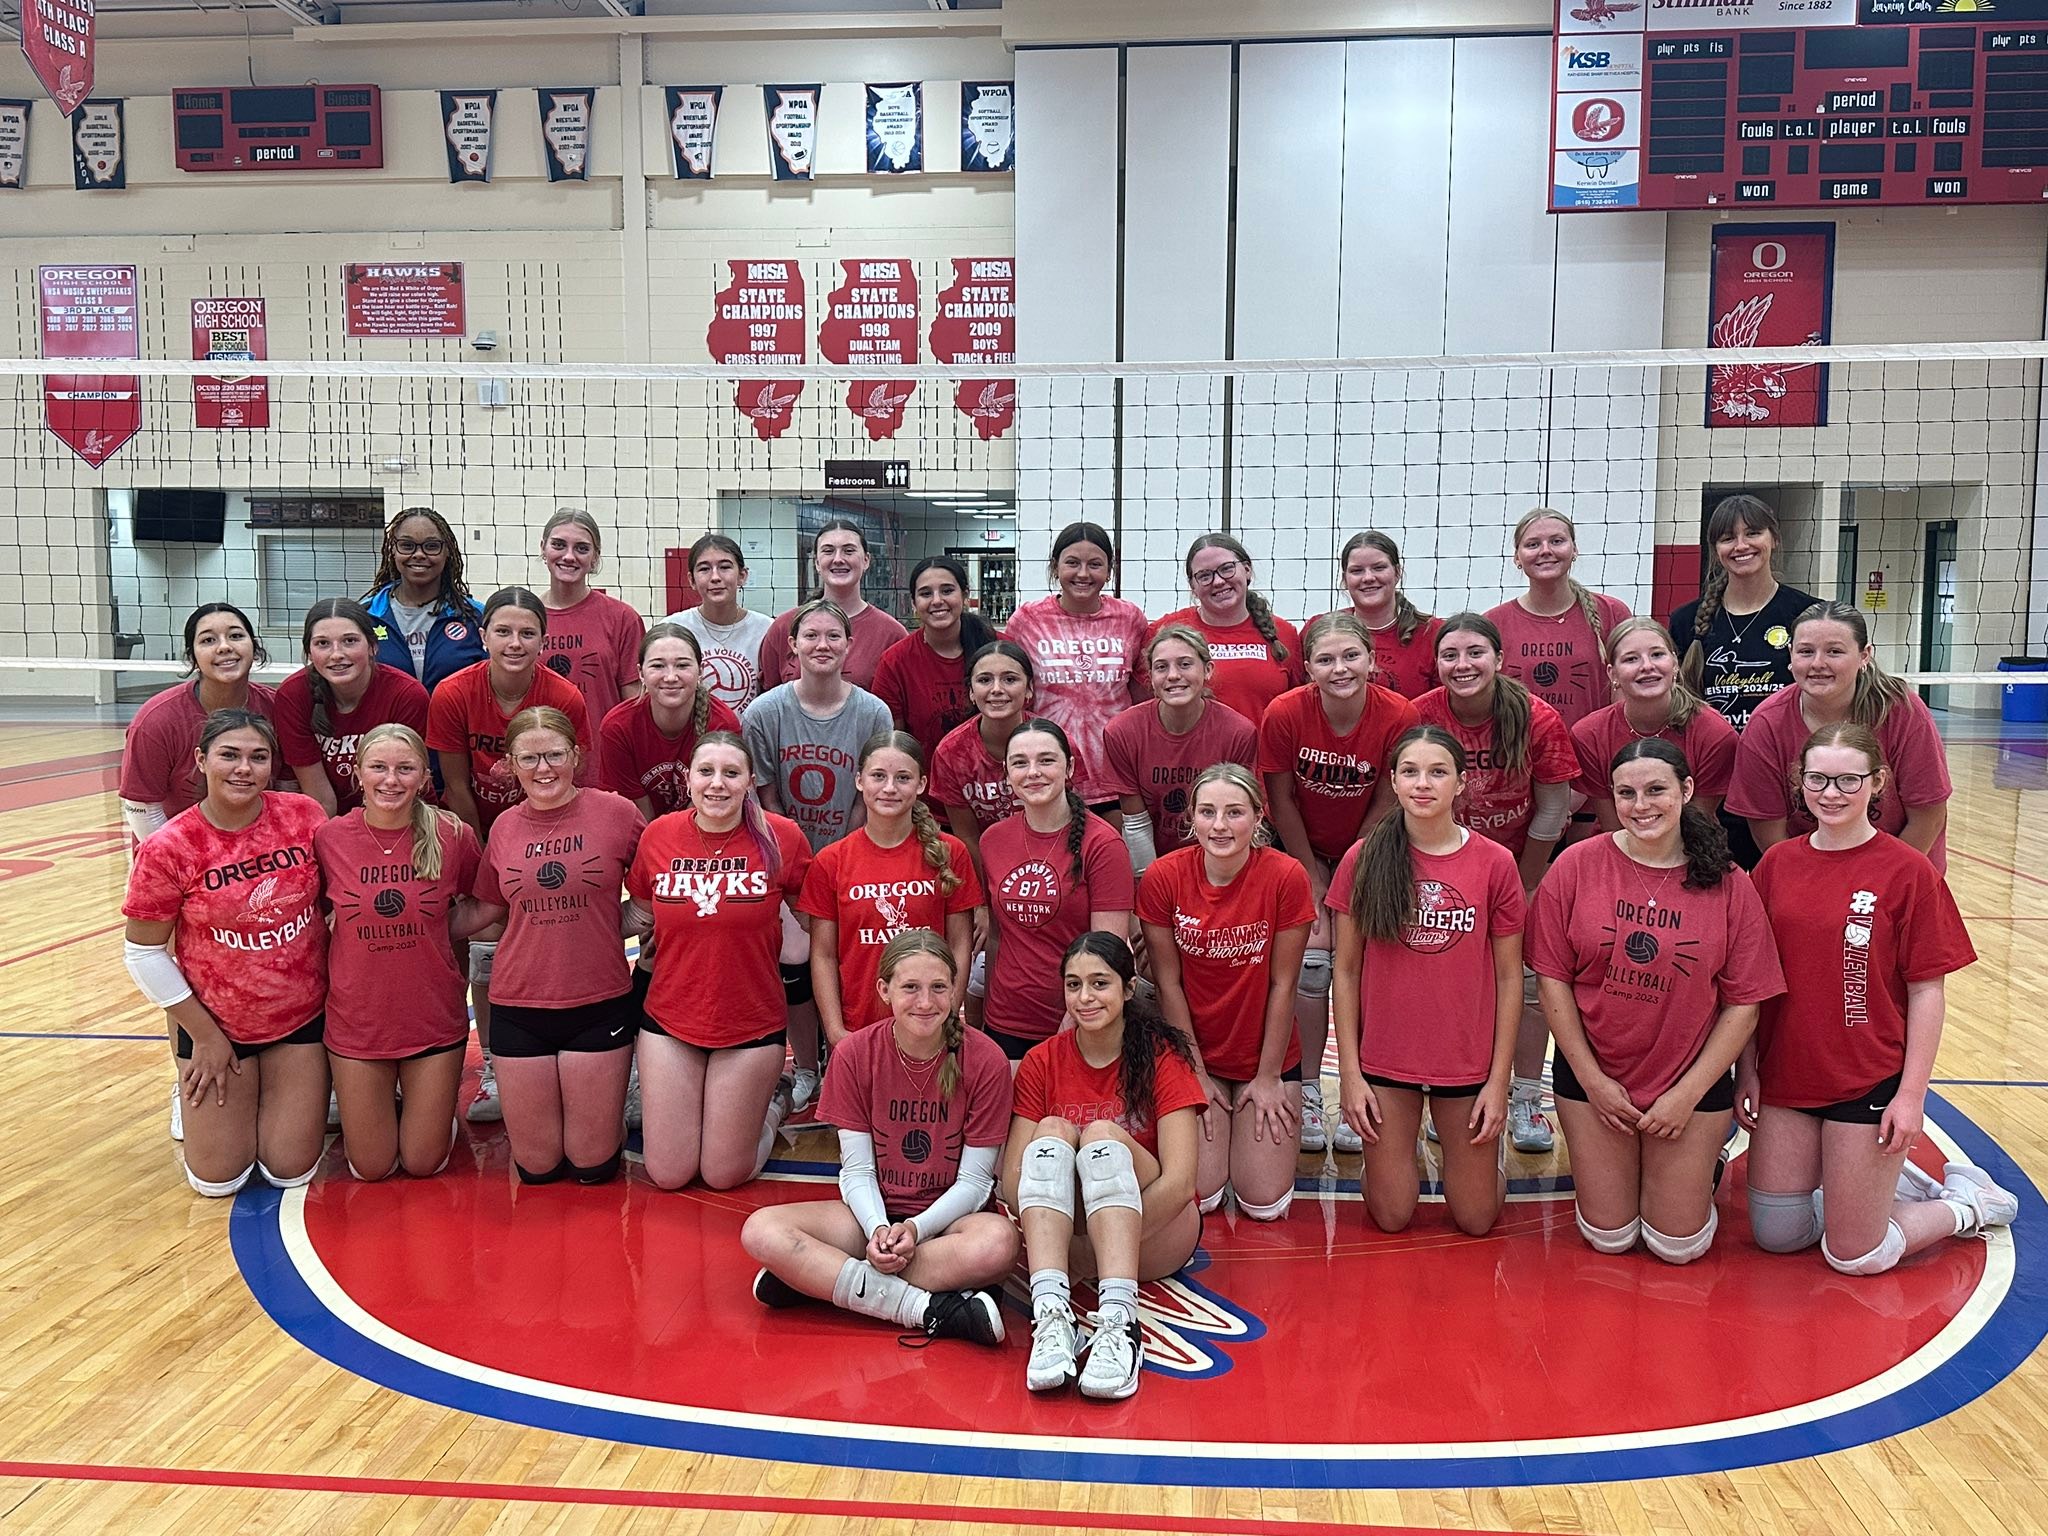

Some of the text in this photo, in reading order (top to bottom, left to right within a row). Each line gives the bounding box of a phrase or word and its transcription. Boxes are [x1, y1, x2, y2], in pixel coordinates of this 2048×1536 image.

[1716, 7, 1750, 16] BANK
[1778, 0, 1832, 11] Since 1882
[37, 3, 55, 23] 4TH
[57, 10, 90, 37] PLACE
[43, 24, 87, 58] CLASS A
[1657, 41, 1724, 56] plyr pts fls
[1992, 33, 2036, 48] plyr pts
[1568, 52, 1611, 69] KSB
[183, 92, 368, 108] Home Guests
[981, 89, 1008, 97] WPOA
[1832, 90, 1877, 111] period
[464, 102, 481, 110] WPOA
[562, 104, 579, 112] WPOA
[788, 100, 808, 109] WPOA
[1741, 122, 1774, 138] fouls
[1830, 119, 1876, 138] player
[1932, 119, 1966, 134] fouls
[256, 145, 294, 162] period
[1742, 180, 1961, 199] won game won
[44, 269, 131, 280] OREGON
[366, 267, 441, 277] HAWKS
[748, 263, 788, 279] IHSA
[859, 262, 901, 279] IHSA
[970, 261, 1013, 278] IHSA
[62, 287, 85, 296] MUSIC
[86, 287, 132, 296] SWEEPSTAKES
[739, 288, 786, 303] STATE
[851, 288, 898, 303] STATE
[962, 287, 1009, 302] STATE
[74, 296, 96, 305] CLASS
[194, 300, 262, 314] OREGON
[722, 304, 803, 320] CHAMPIONS
[834, 304, 916, 319] CHAMPIONS
[944, 303, 1015, 318] CHAMPION
[194, 314, 263, 329] HIGH SCHOOL
[969, 322, 1002, 336] 2009
[211, 331, 247, 342] BEST
[748, 323, 777, 337] 1997
[859, 323, 890, 337] 1998
[224, 342, 248, 351] SCHOOLS
[750, 340, 776, 351] BOYS
[849, 340, 900, 351] DUAL TEAM
[972, 339, 998, 350] BOYS
[724, 354, 802, 364] CROSS COUNTRY
[848, 353, 902, 364] WRESTLING
[952, 352, 984, 364] TRACK
[985, 354, 993, 364] &
[543, 634, 583, 650] REGON
[1037, 638, 1124, 655] OREGON
[1208, 643, 1267, 653] OREGON
[1521, 641, 1574, 657] OREGON
[1209, 651, 1266, 659] VOLLEYBALL
[1038, 670, 1126, 685] VOLLEYBALL
[1714, 671, 1775, 688] Volleyball
[1743, 683, 1785, 693] 2024/25
[1538, 692, 1574, 705] EYBALL
[469, 733, 506, 753] ORE
[778, 743, 855, 773] OREGON
[1298, 747, 1357, 767] OREGON
[789, 764, 836, 806] O
[962, 780, 1013, 800] OREG
[1302, 780, 1366, 799] Volleyball
[787, 805, 845, 825] AWKS
[1459, 797, 1530, 829] LEYBAL
[525, 834, 583, 859] OREGON
[204, 846, 309, 891] OREGON
[670, 856, 748, 873] OREGON
[654, 871, 768, 896] HAWKS
[1001, 862, 1058, 896] AEROPOSTALE
[849, 880, 935, 900] OREGON
[1018, 880, 1041, 898] 87
[519, 894, 589, 913] VOLLEYBALL
[1006, 902, 1051, 914] NEW YORK
[530, 914, 580, 926] Camp 2023
[1018, 913, 1040, 923] CITY
[1413, 906, 1477, 932] DGERS
[1616, 899, 1682, 930] OREGON
[210, 905, 316, 951] VOLLEYBALL
[356, 923, 426, 941] VOLLEYBALL
[858, 926, 931, 944] HAW
[1177, 920, 1269, 949] DY HAWKS
[1406, 927, 1450, 944] Hoops
[367, 940, 417, 953] Camp 2023
[1174, 932, 1268, 959] MMER SHOOTOUT
[1605, 964, 1673, 993] OLLEYBALL
[1604, 983, 1659, 1005] Camp 2023
[889, 1099, 949, 1123] OREGON
[1049, 1100, 1124, 1125] OREGO
[880, 1167, 948, 1188] VOLLEYBALL
